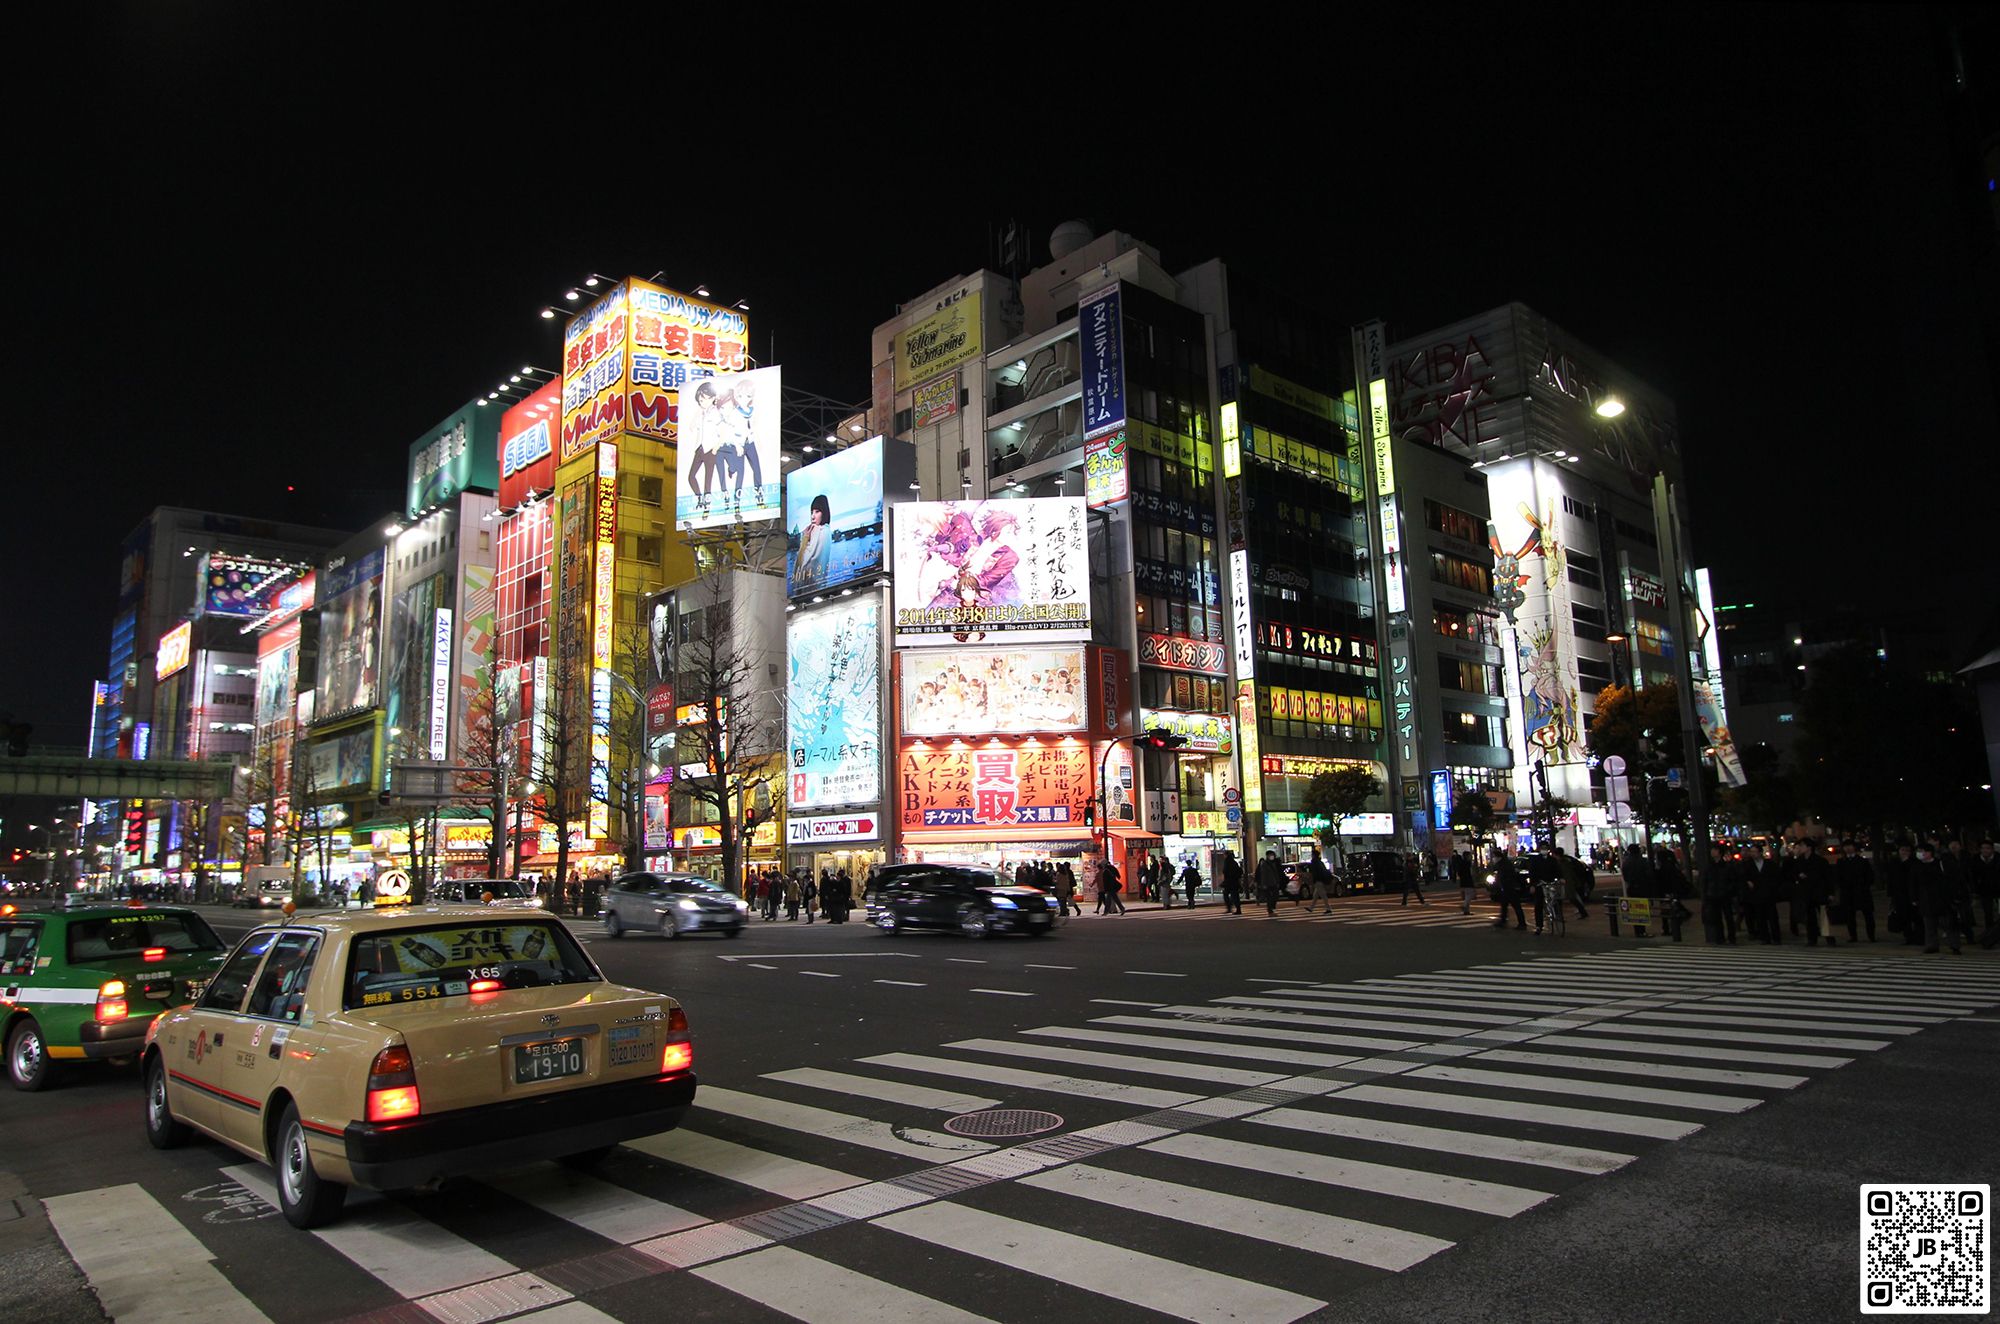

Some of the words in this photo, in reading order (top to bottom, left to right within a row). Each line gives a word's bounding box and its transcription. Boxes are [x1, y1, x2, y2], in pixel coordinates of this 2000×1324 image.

[565, 314, 625, 376] 激安販売
[634, 315, 746, 370] 激安販売
[905, 328, 940, 356] Yellow
[910, 331, 967, 370] Submarine
[563, 392, 625, 457] Mulan
[1374, 405, 1383, 434] Yellow
[503, 421, 551, 476] SEGA
[1087, 451, 1125, 475] まんが
[1376, 441, 1387, 490] Submarine
[1141, 636, 1226, 670] メイドカジノ
[536, 660, 547, 688] GAME
[1103, 653, 1117, 709] 買取
[435, 678, 447, 712] DUTY
[1393, 656, 1412, 761] リバティー
[434, 717, 446, 749] FREE
[924, 754, 939, 806] アイドル
[939, 753, 955, 793] アニメ
[955, 752, 971, 807] 美少女系
[974, 752, 1018, 823] 買取
[1021, 751, 1038, 806] フィギュア
[1037, 750, 1052, 790] ホビー
[1053, 750, 1071, 805] 携帯電話
[1071, 749, 1086, 822] アップルとか
[790, 819, 812, 841] ZIN
[814, 822, 844, 836] COMIC
[844, 821, 860, 833] ZIN
[925, 809, 973, 825] チケット
[1022, 807, 1069, 822] 大黒屋
[451, 943, 516, 962] シャキ
[362, 991, 393, 1005] 無線
[401, 984, 441, 1001] 554
[532, 1045, 551, 1058] 足立
[552, 1043, 569, 1054] 500
[533, 1052, 580, 1079] 19-10
